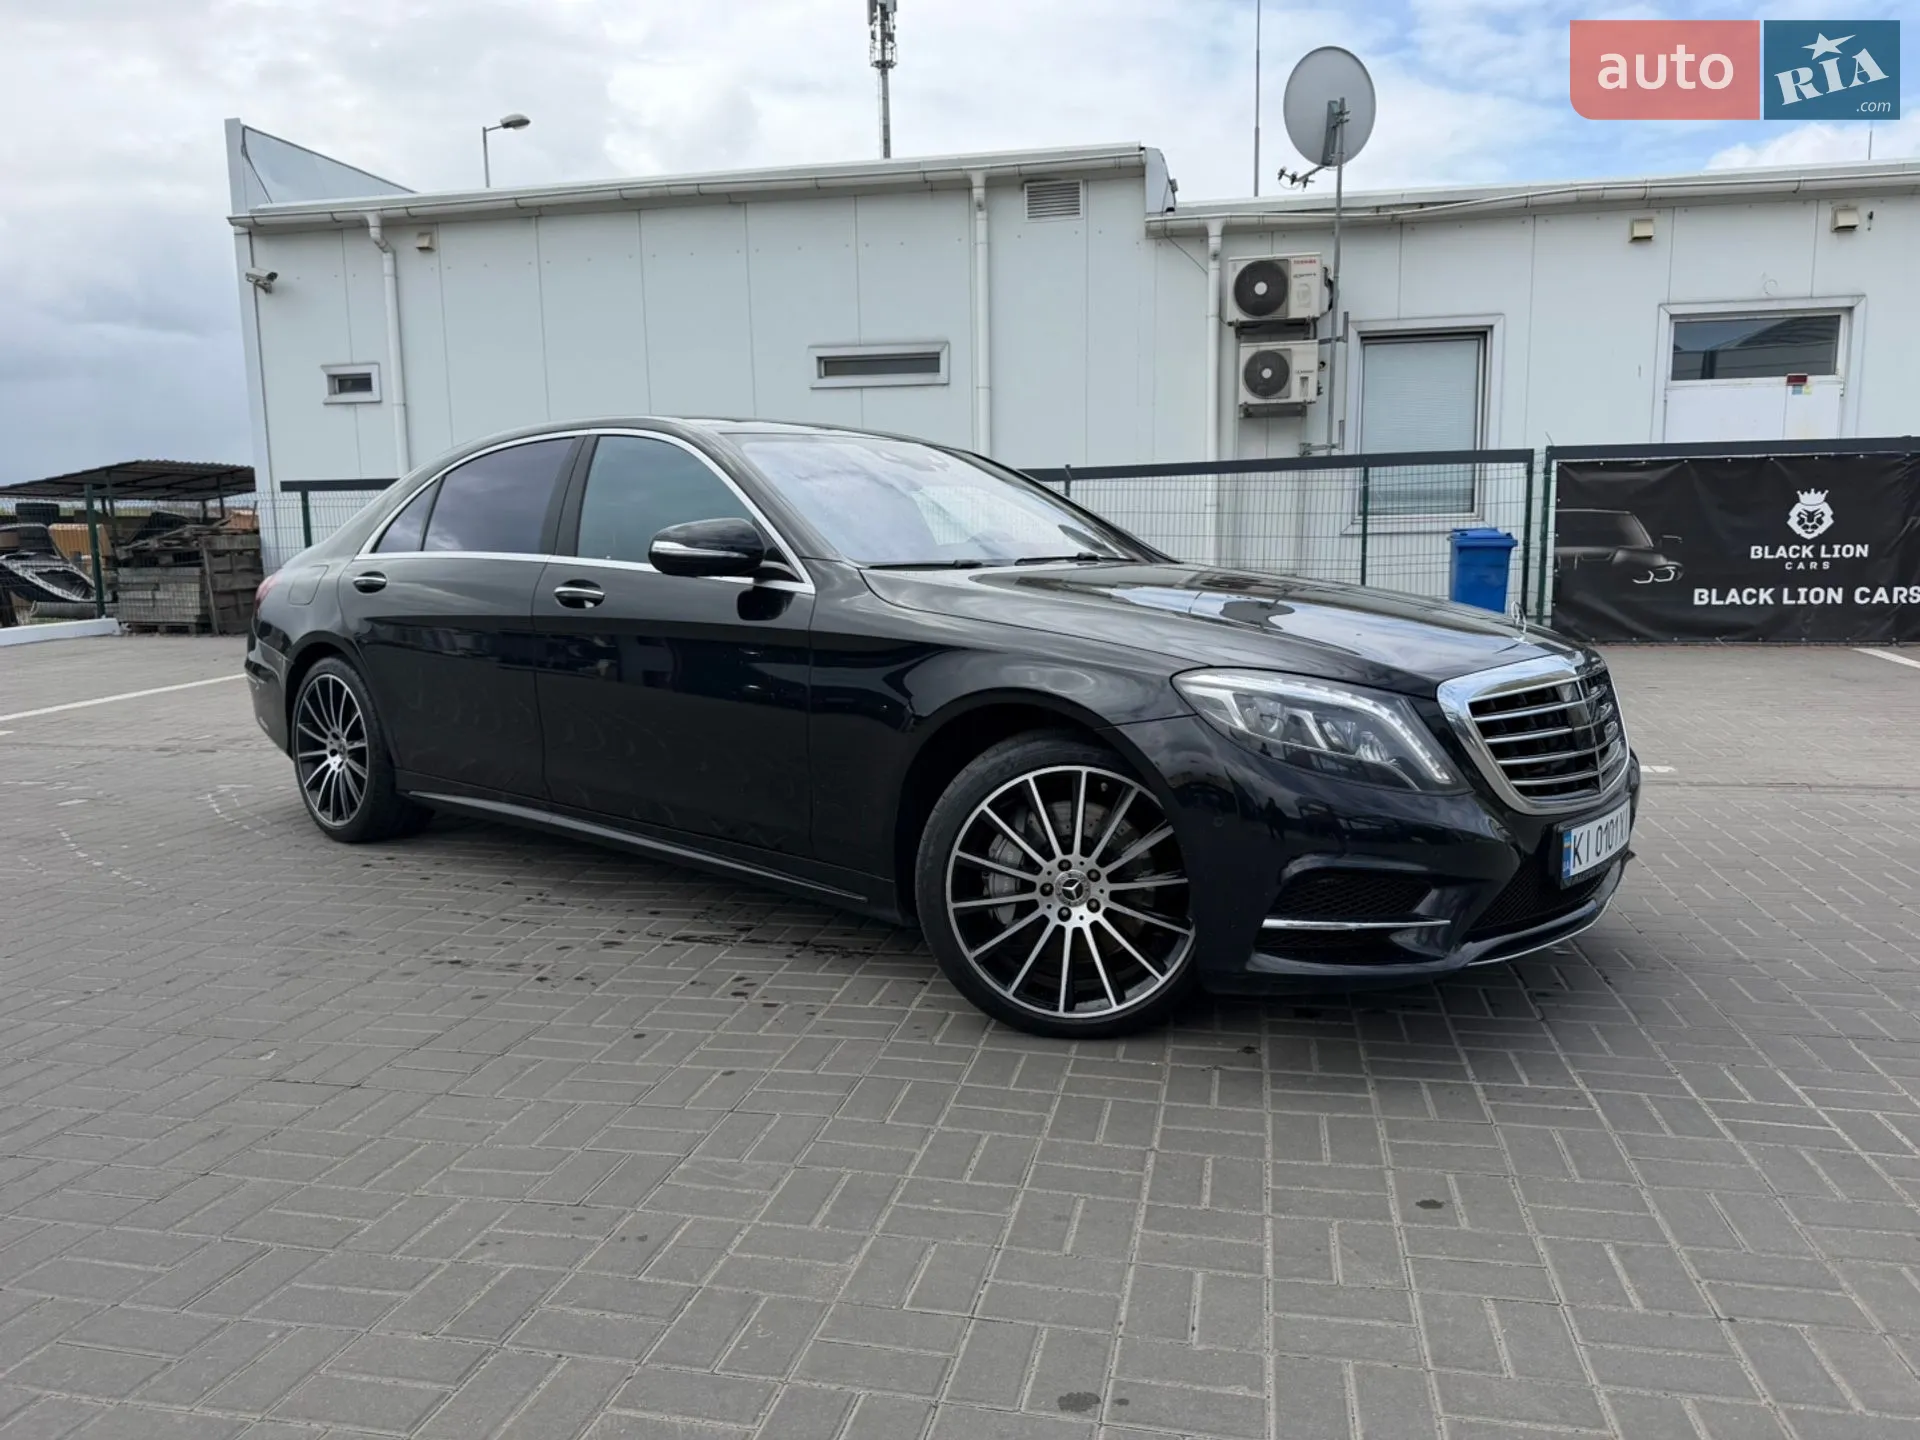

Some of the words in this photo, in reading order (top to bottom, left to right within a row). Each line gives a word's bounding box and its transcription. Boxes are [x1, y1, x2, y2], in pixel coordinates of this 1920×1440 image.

[1750, 545, 1814, 559] BLACK
[1820, 544, 1869, 558] LION
[1785, 561, 1830, 570] CARS
[1693, 588, 1775, 605] BLACK
[1782, 587, 1843, 604] LION
[1853, 586, 1920, 604] CARS
